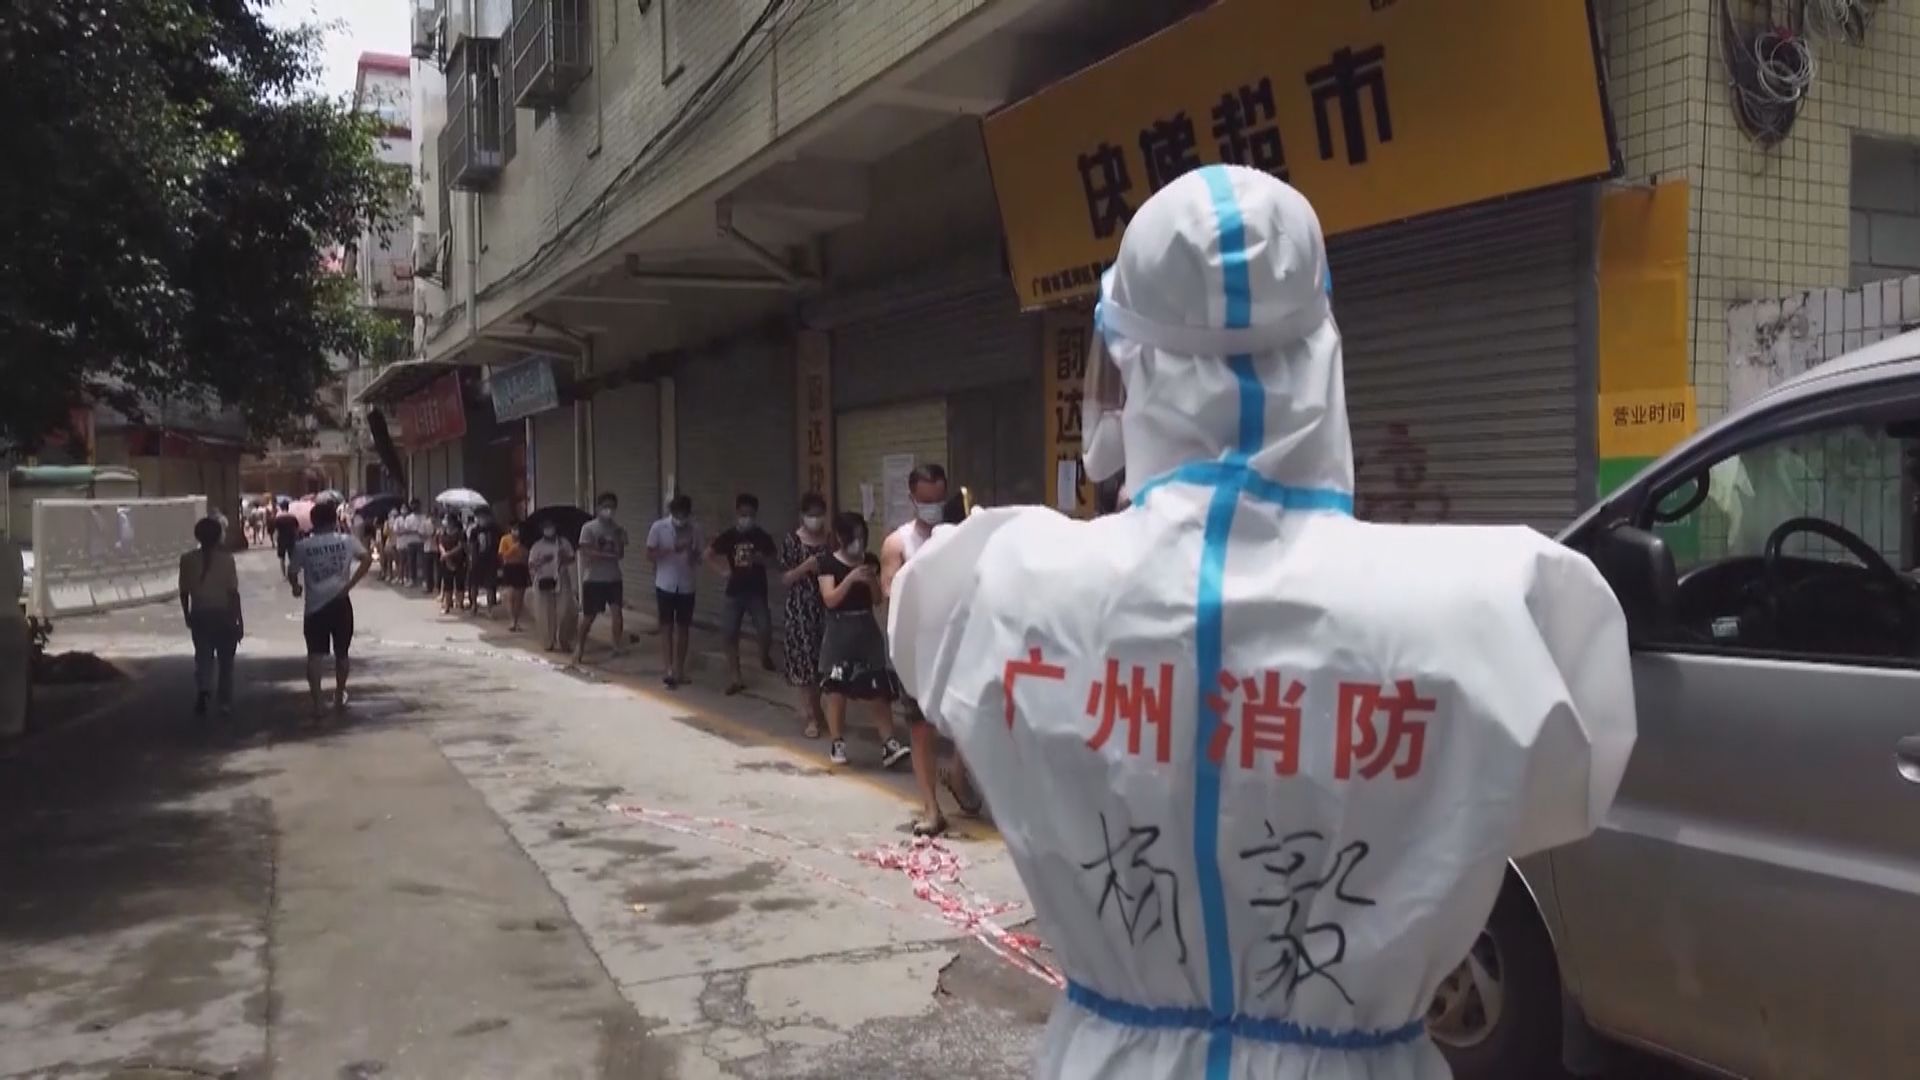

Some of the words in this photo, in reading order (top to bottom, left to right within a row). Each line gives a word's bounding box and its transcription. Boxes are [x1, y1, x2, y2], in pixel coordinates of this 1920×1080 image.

[1613, 402, 1685, 426] 营业时间
[1003, 646, 1437, 780] 广州消防
